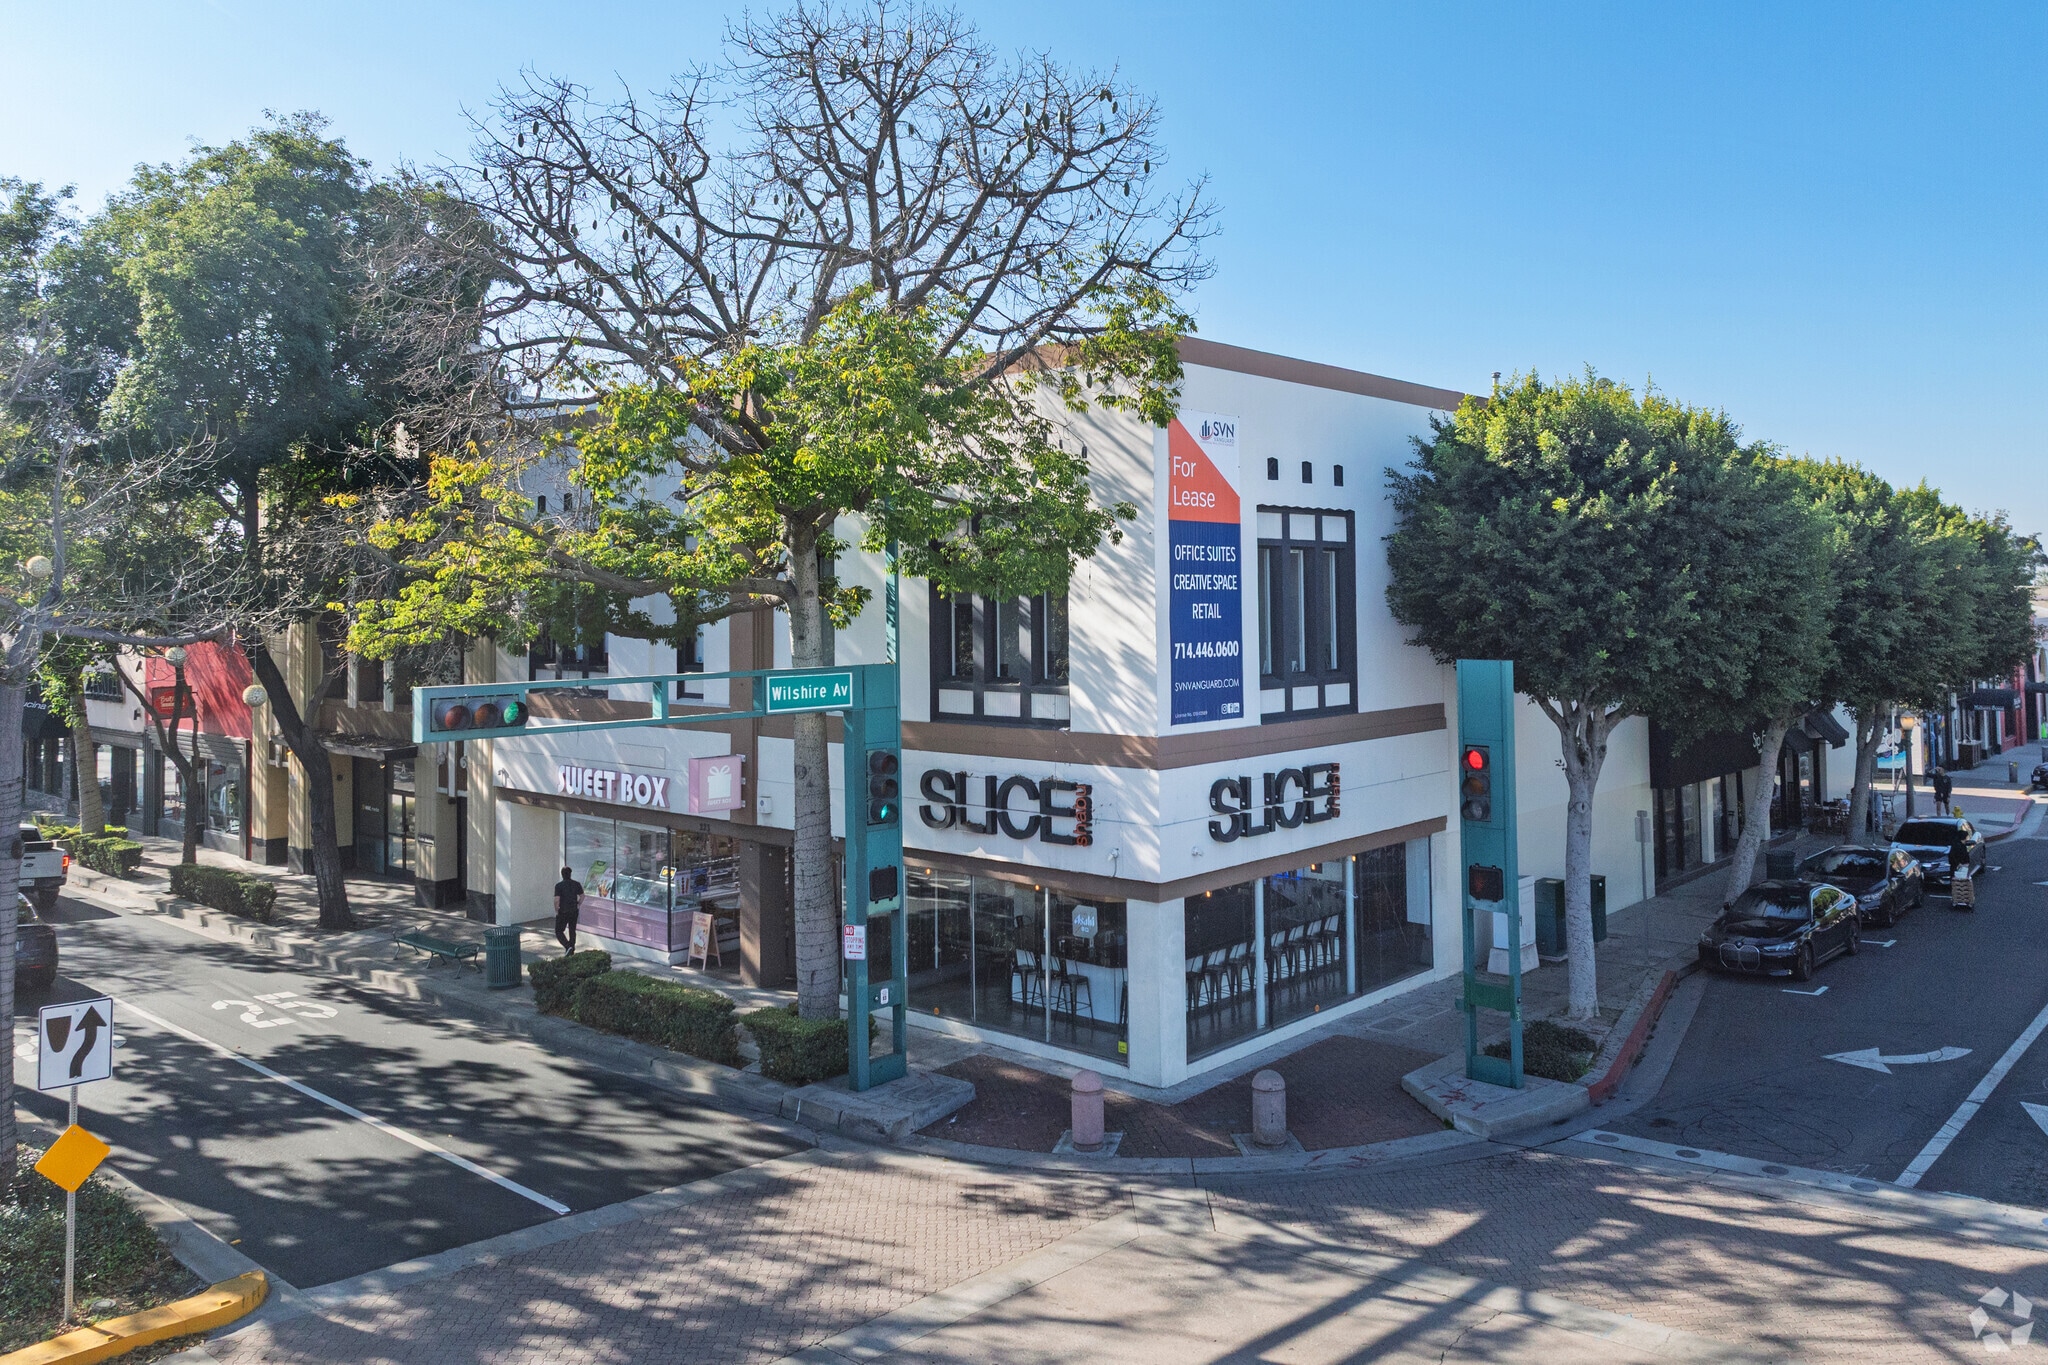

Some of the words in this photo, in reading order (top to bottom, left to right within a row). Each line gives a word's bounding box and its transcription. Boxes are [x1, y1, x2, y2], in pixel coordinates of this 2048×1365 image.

[1213, 421, 1234, 438] SVN
[1173, 455, 1197, 478] For
[1173, 485, 1216, 508] Lease
[1174, 544, 1205, 561] OFFICE
[1207, 545, 1236, 562] SUITES
[1173, 573, 1212, 590] CREATIVE
[1213, 574, 1238, 590] SPACE
[1192, 603, 1222, 620] RETAIL
[1174, 640, 1239, 660] 714.446.0600
[771, 683, 827, 701] Wilshire
[833, 682, 848, 697] Av
[1174, 678, 1240, 692] SVNVANGUARD.COM
[558, 765, 616, 801] SWEET
[620, 773, 671, 808] BOX
[919, 769, 1079, 846] SLICE
[1208, 763, 1333, 843] SLICE
[1074, 783, 1092, 847] shabu
[1074, 914, 1095, 928] Asahi
[845, 926, 854, 936] NO
[845, 936, 865, 945] STOPPING
[211, 991, 339, 1029] 25
